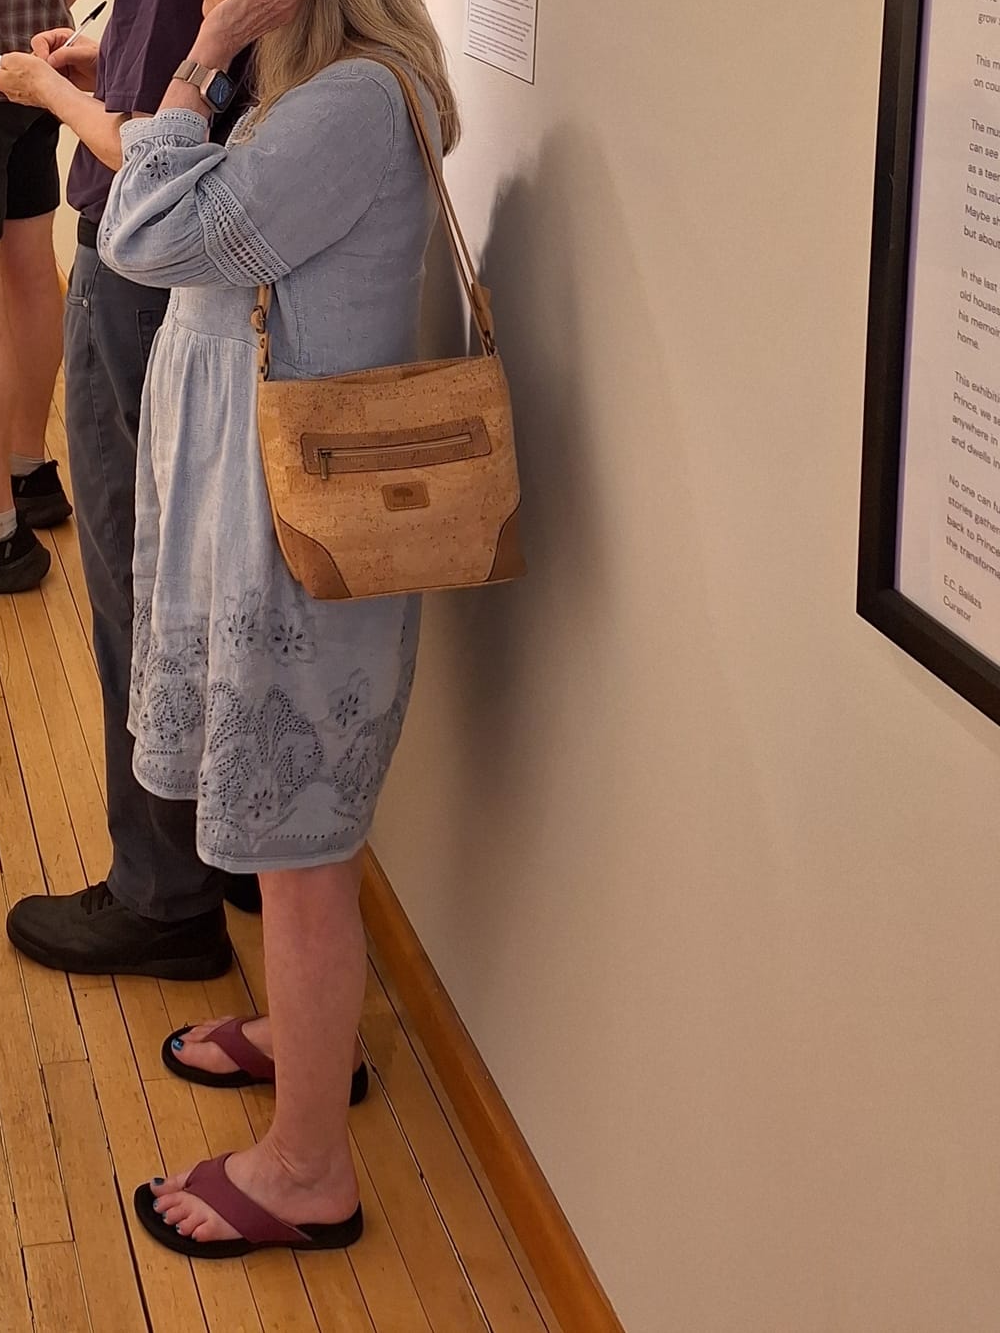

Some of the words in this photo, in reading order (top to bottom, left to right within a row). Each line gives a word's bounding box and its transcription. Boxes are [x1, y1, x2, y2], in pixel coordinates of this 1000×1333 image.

[978, 13, 997, 25] grow
[976, 53, 990, 68] This
[973, 77, 984, 88] on
[971, 117, 985, 133] The
[969, 142, 983, 154] can
[985, 147, 999, 160] see
[968, 164, 977, 174] as
[967, 183, 977, 196] his
[965, 203, 991, 223] Maybe
[963, 225, 977, 240] but
[961, 267, 968, 280] In
[969, 272, 982, 286] the
[983, 276, 998, 292] last
[960, 289, 972, 303] old
[958, 308, 969, 323] his
[954, 370, 970, 388] This
[952, 414, 989, 441] anywhere
[951, 435, 966, 450] and
[966, 443, 991, 465] dwells
[949, 473, 960, 489] No
[960, 484, 976, 498] one
[977, 493, 992, 509] can
[948, 496, 973, 519] stories
[946, 513, 965, 535] back
[966, 527, 976, 541] to
[946, 535, 959, 551] the
[943, 594, 972, 623] Curator
